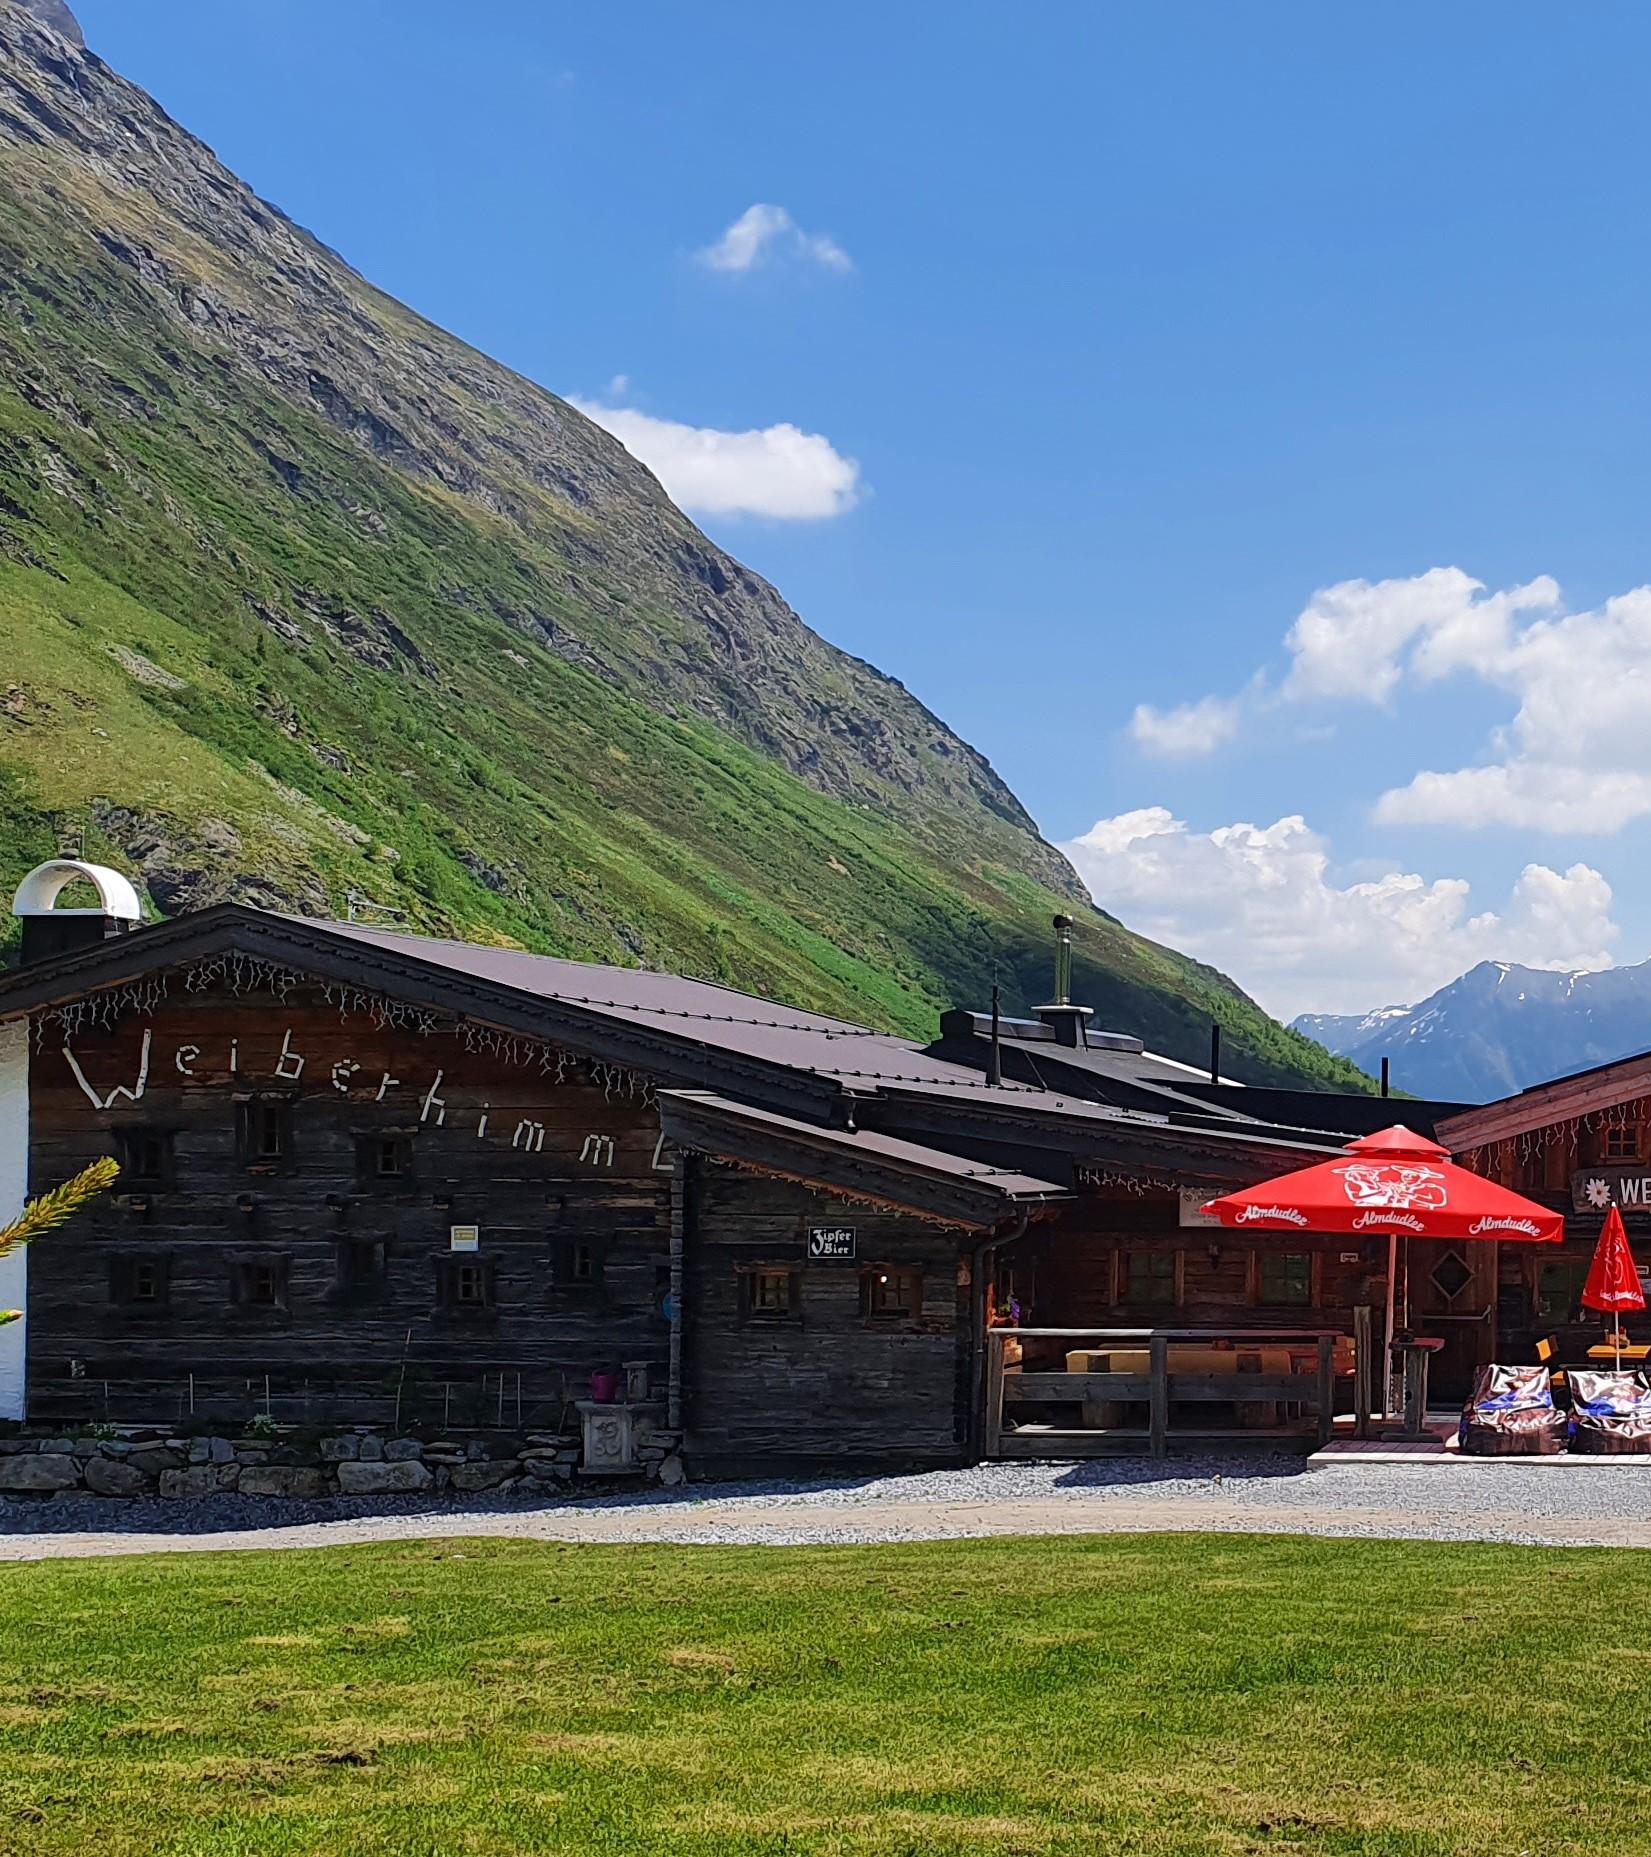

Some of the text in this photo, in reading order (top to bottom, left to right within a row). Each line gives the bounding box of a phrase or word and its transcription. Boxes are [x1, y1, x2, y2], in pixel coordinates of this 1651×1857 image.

[1235, 1204, 1307, 1227] Almdudler
[1352, 1210, 1425, 1232] Almdudler
[1468, 1216, 1541, 1236] Almdudler
[811, 1229, 852, 1256] Zipfer
[823, 1242, 849, 1254] Bier
